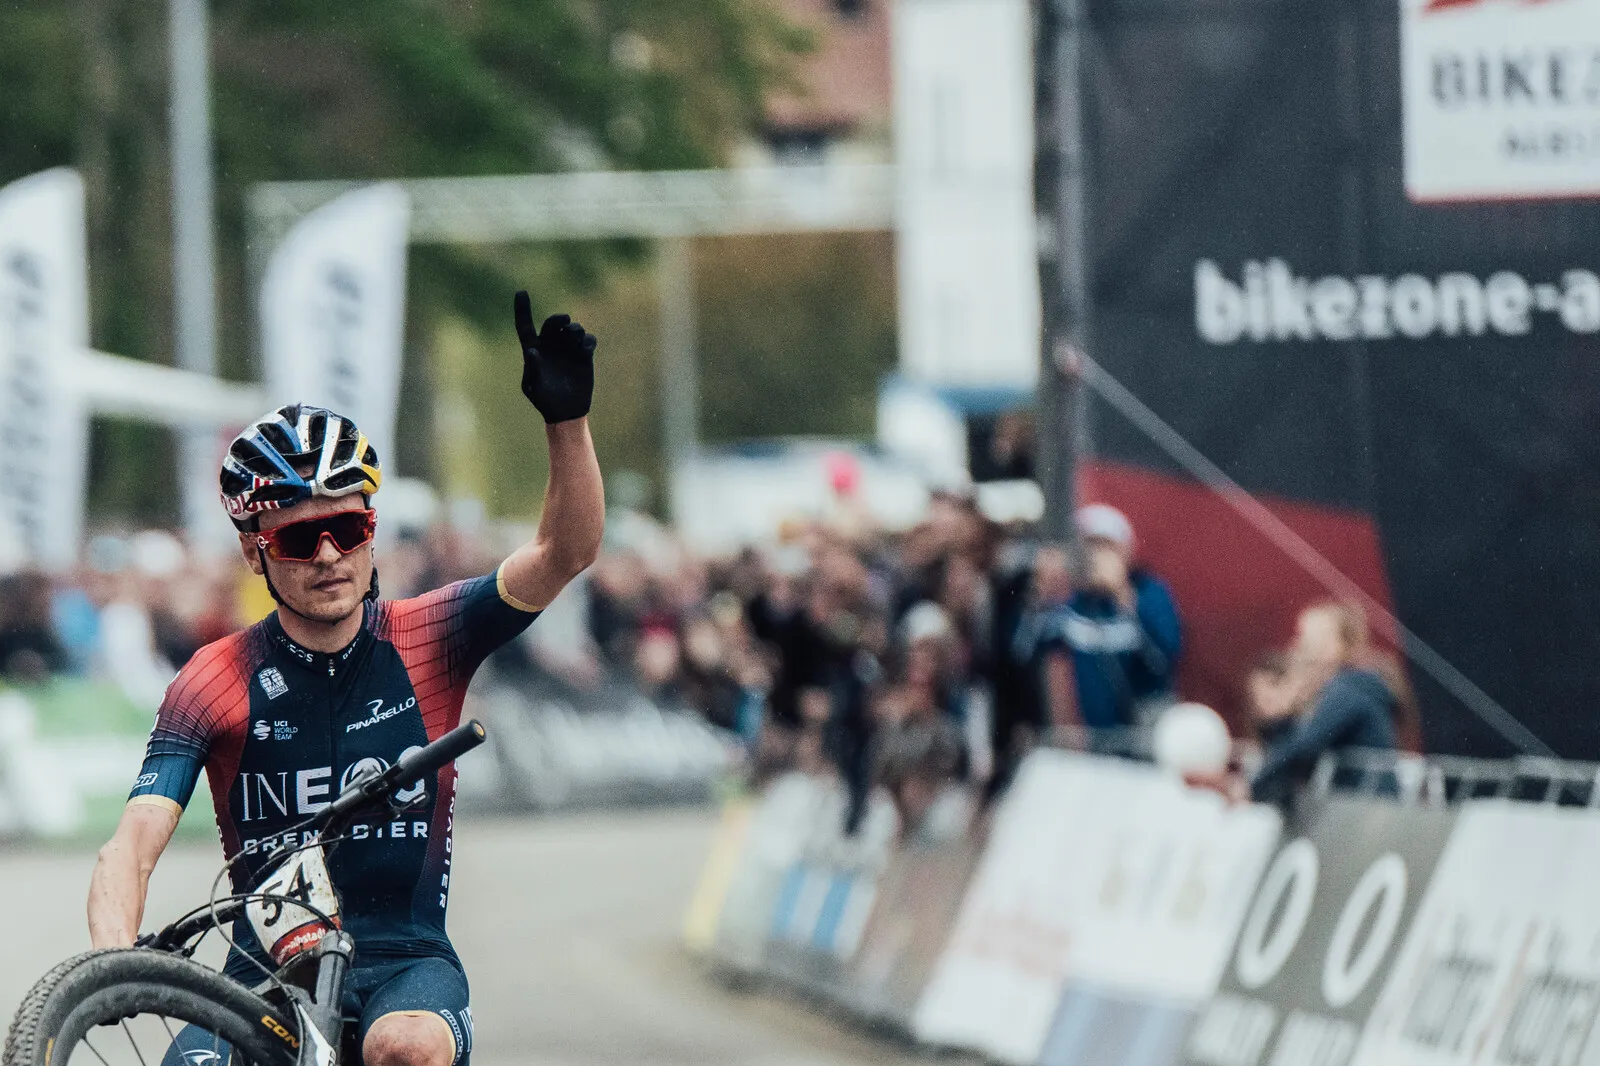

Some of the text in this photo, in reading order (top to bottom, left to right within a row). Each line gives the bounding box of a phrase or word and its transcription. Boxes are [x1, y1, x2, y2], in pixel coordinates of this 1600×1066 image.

[1428, 48, 1600, 108] BIKE
[346, 696, 416, 733] PINARELLO
[243, 821, 429, 856] GRENDIER
[261, 861, 315, 928] 54
